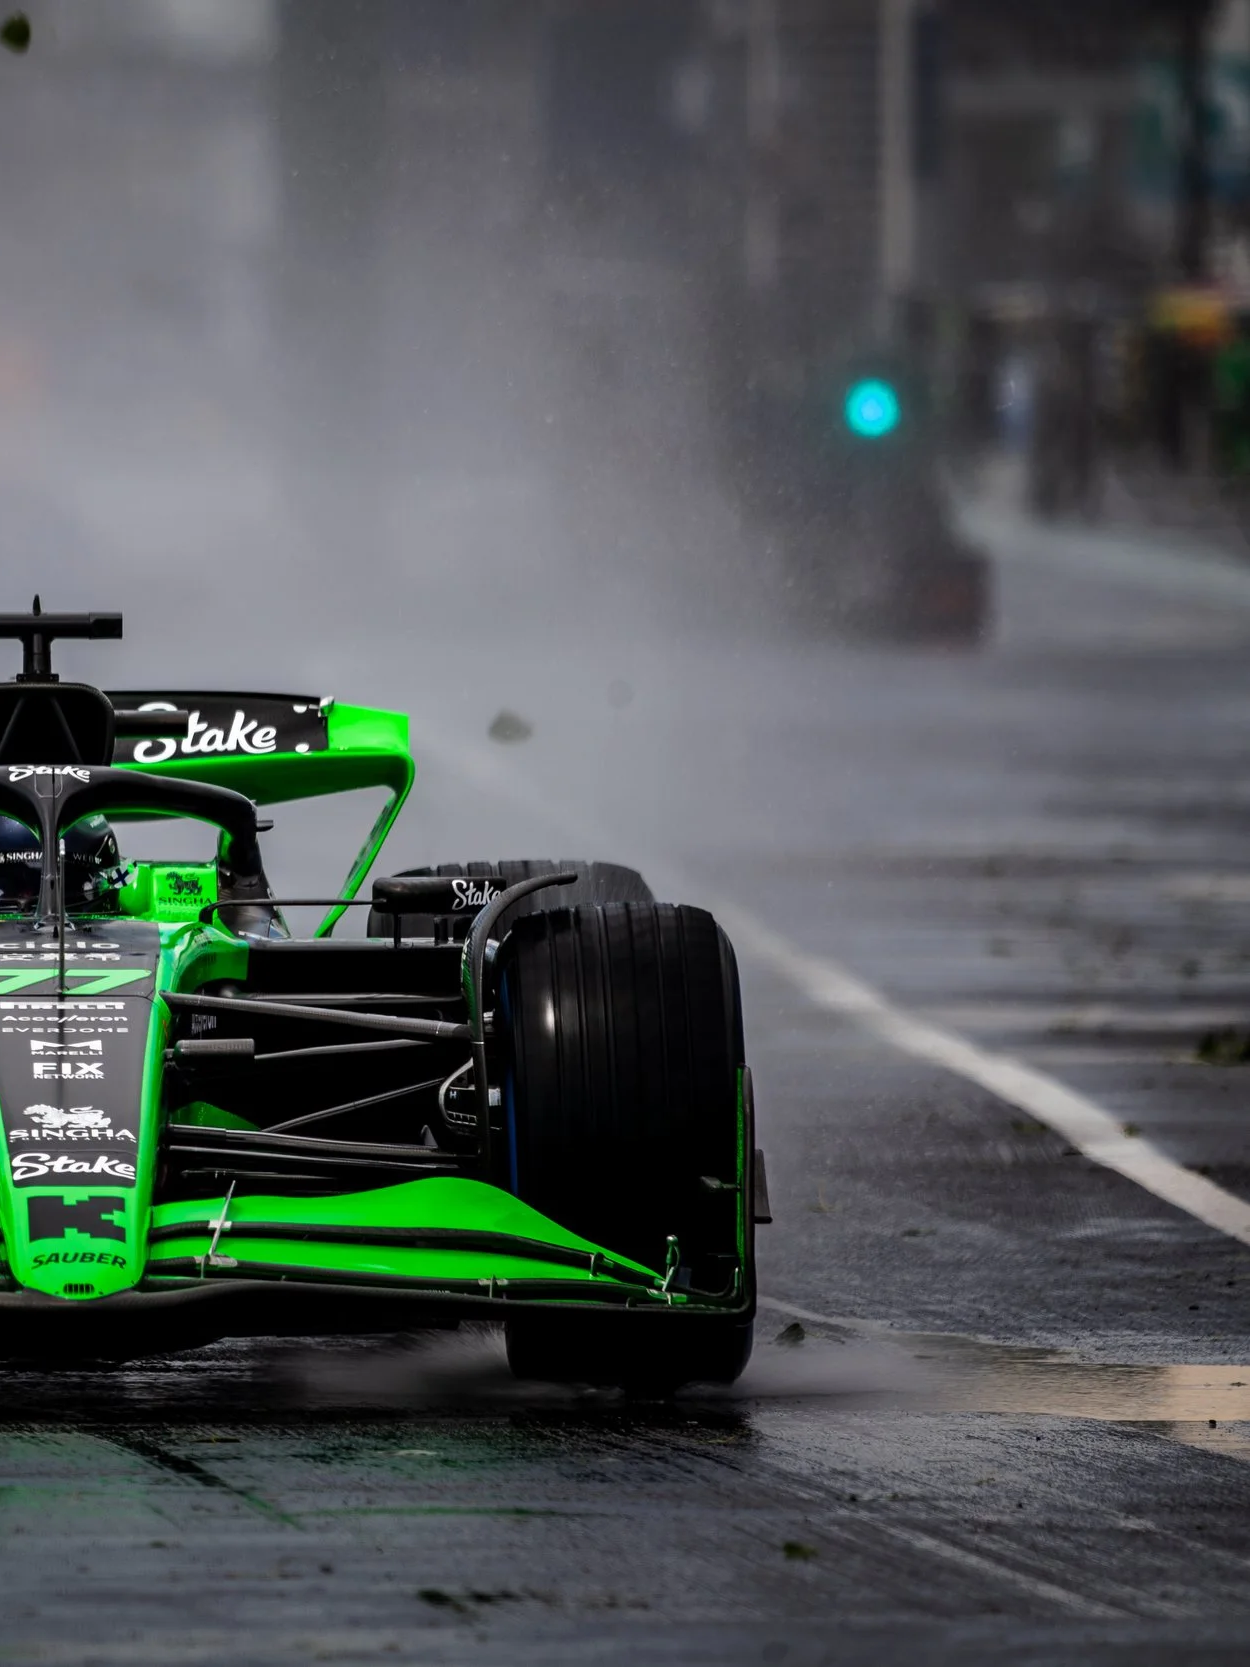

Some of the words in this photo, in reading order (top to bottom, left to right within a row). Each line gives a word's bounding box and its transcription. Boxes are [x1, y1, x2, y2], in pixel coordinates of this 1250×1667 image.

[133, 701, 277, 764] Stake
[8, 765, 90, 783] Stake
[452, 879, 501, 911] Stake
[33, 1062, 104, 1075] FIX
[9, 1129, 136, 1140] SINGHA
[11, 1152, 137, 1181] Stake
[31, 1252, 127, 1270] SAUBER
